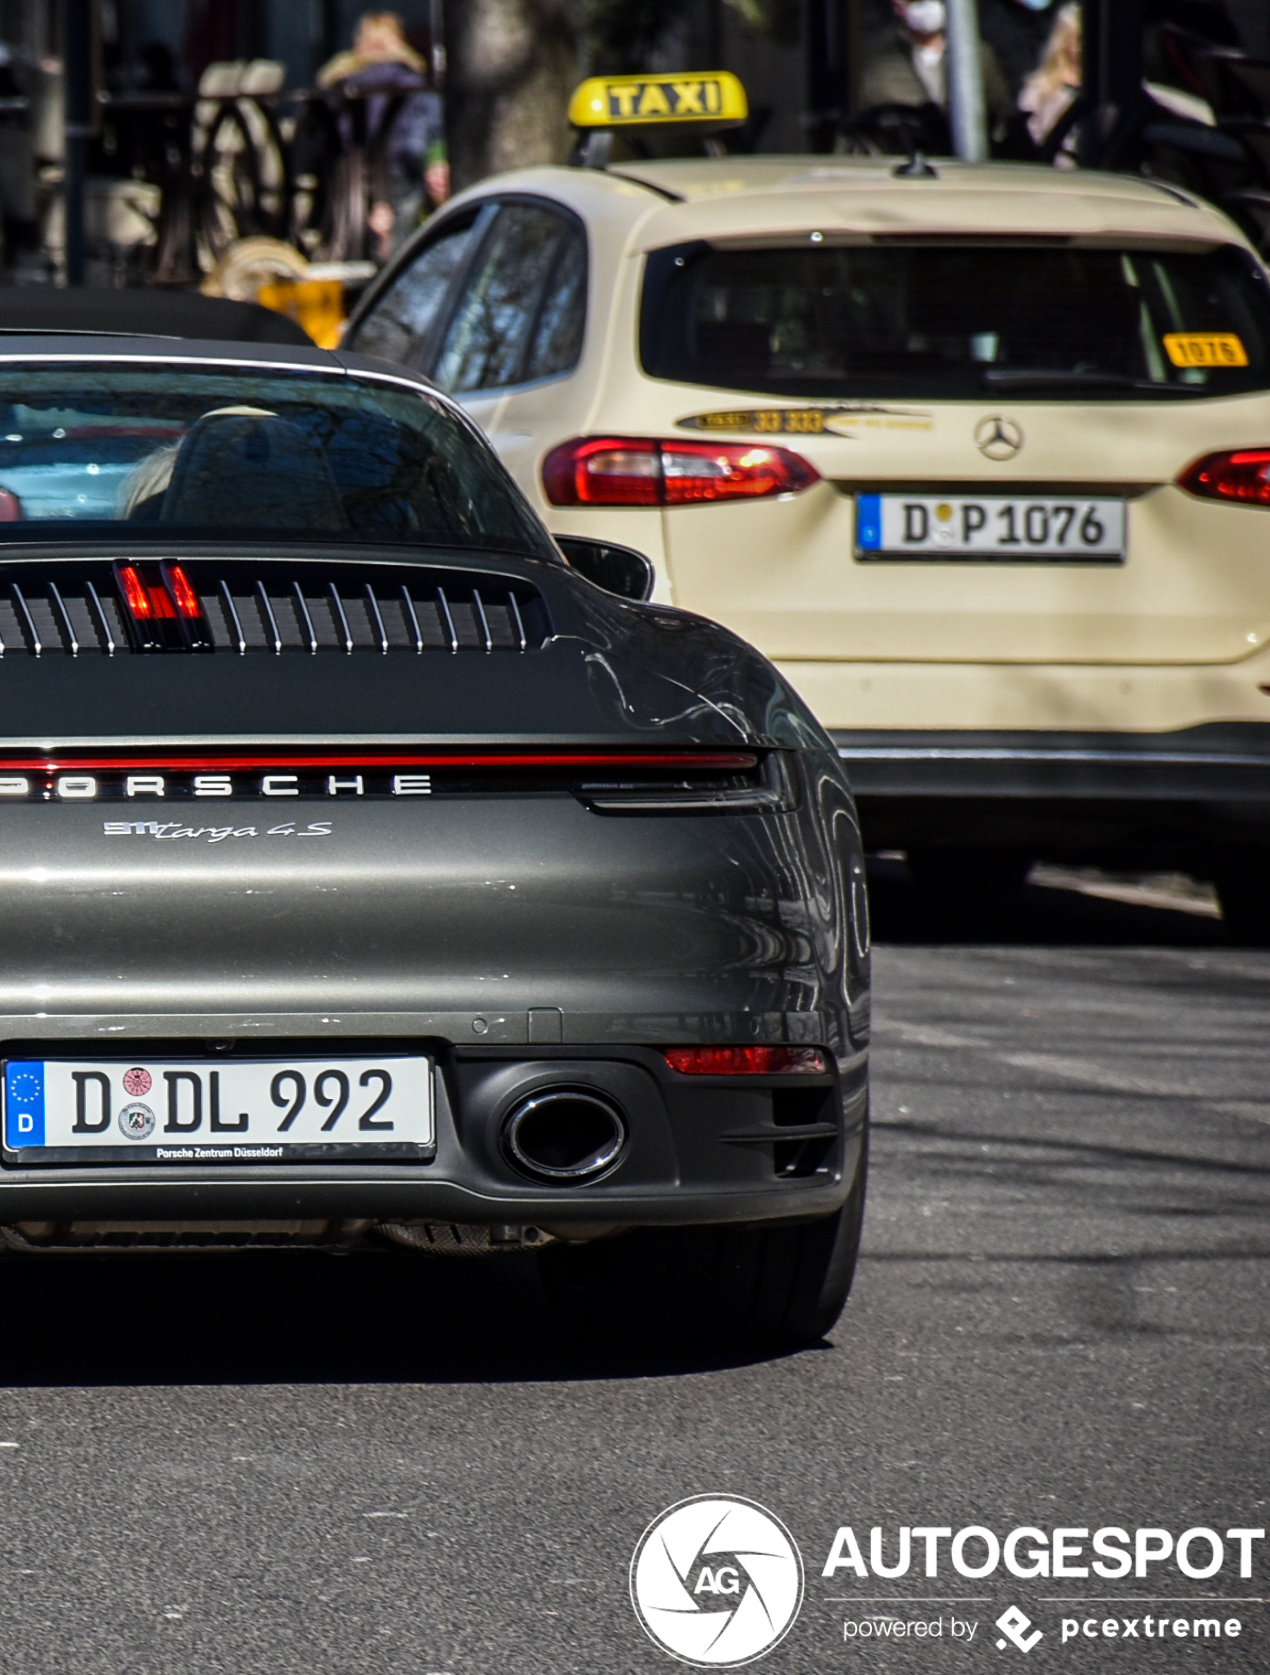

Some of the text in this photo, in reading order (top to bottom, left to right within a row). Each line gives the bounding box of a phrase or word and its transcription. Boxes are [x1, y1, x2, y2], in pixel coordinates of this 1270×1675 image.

[609, 82, 720, 116] TAXI
[904, 504, 1104, 546] D P 1076
[155, 821, 259, 843] targa
[71, 1071, 111, 1133] D
[163, 1071, 249, 1133] DL
[270, 1069, 394, 1132] 992
[18, 1114, 34, 1132] D
[156, 1147, 283, 1159] Porsche Zentrum Düsseldorf
